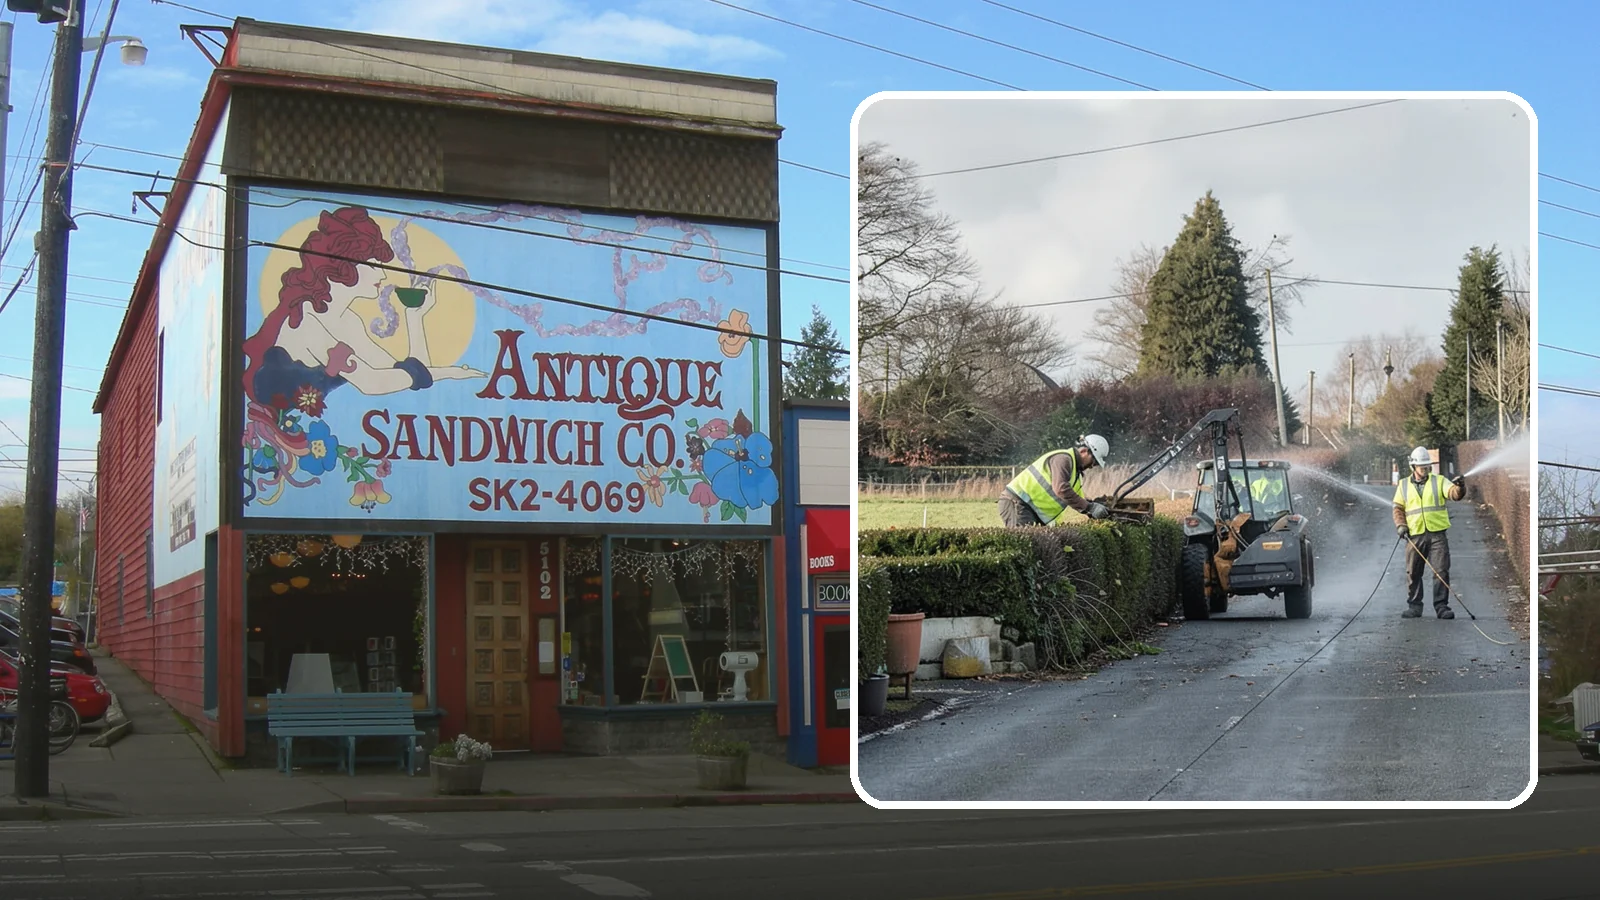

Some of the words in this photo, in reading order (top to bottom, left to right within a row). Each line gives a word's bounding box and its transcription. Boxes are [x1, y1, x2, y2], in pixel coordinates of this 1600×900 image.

[475, 328, 724, 422] ANTIQUE
[361, 408, 605, 467] SANDWICH
[616, 421, 685, 469] CO.
[468, 477, 646, 513] SK2-4069
[539, 541, 552, 600] 5102
[809, 555, 835, 569] BOOKS
